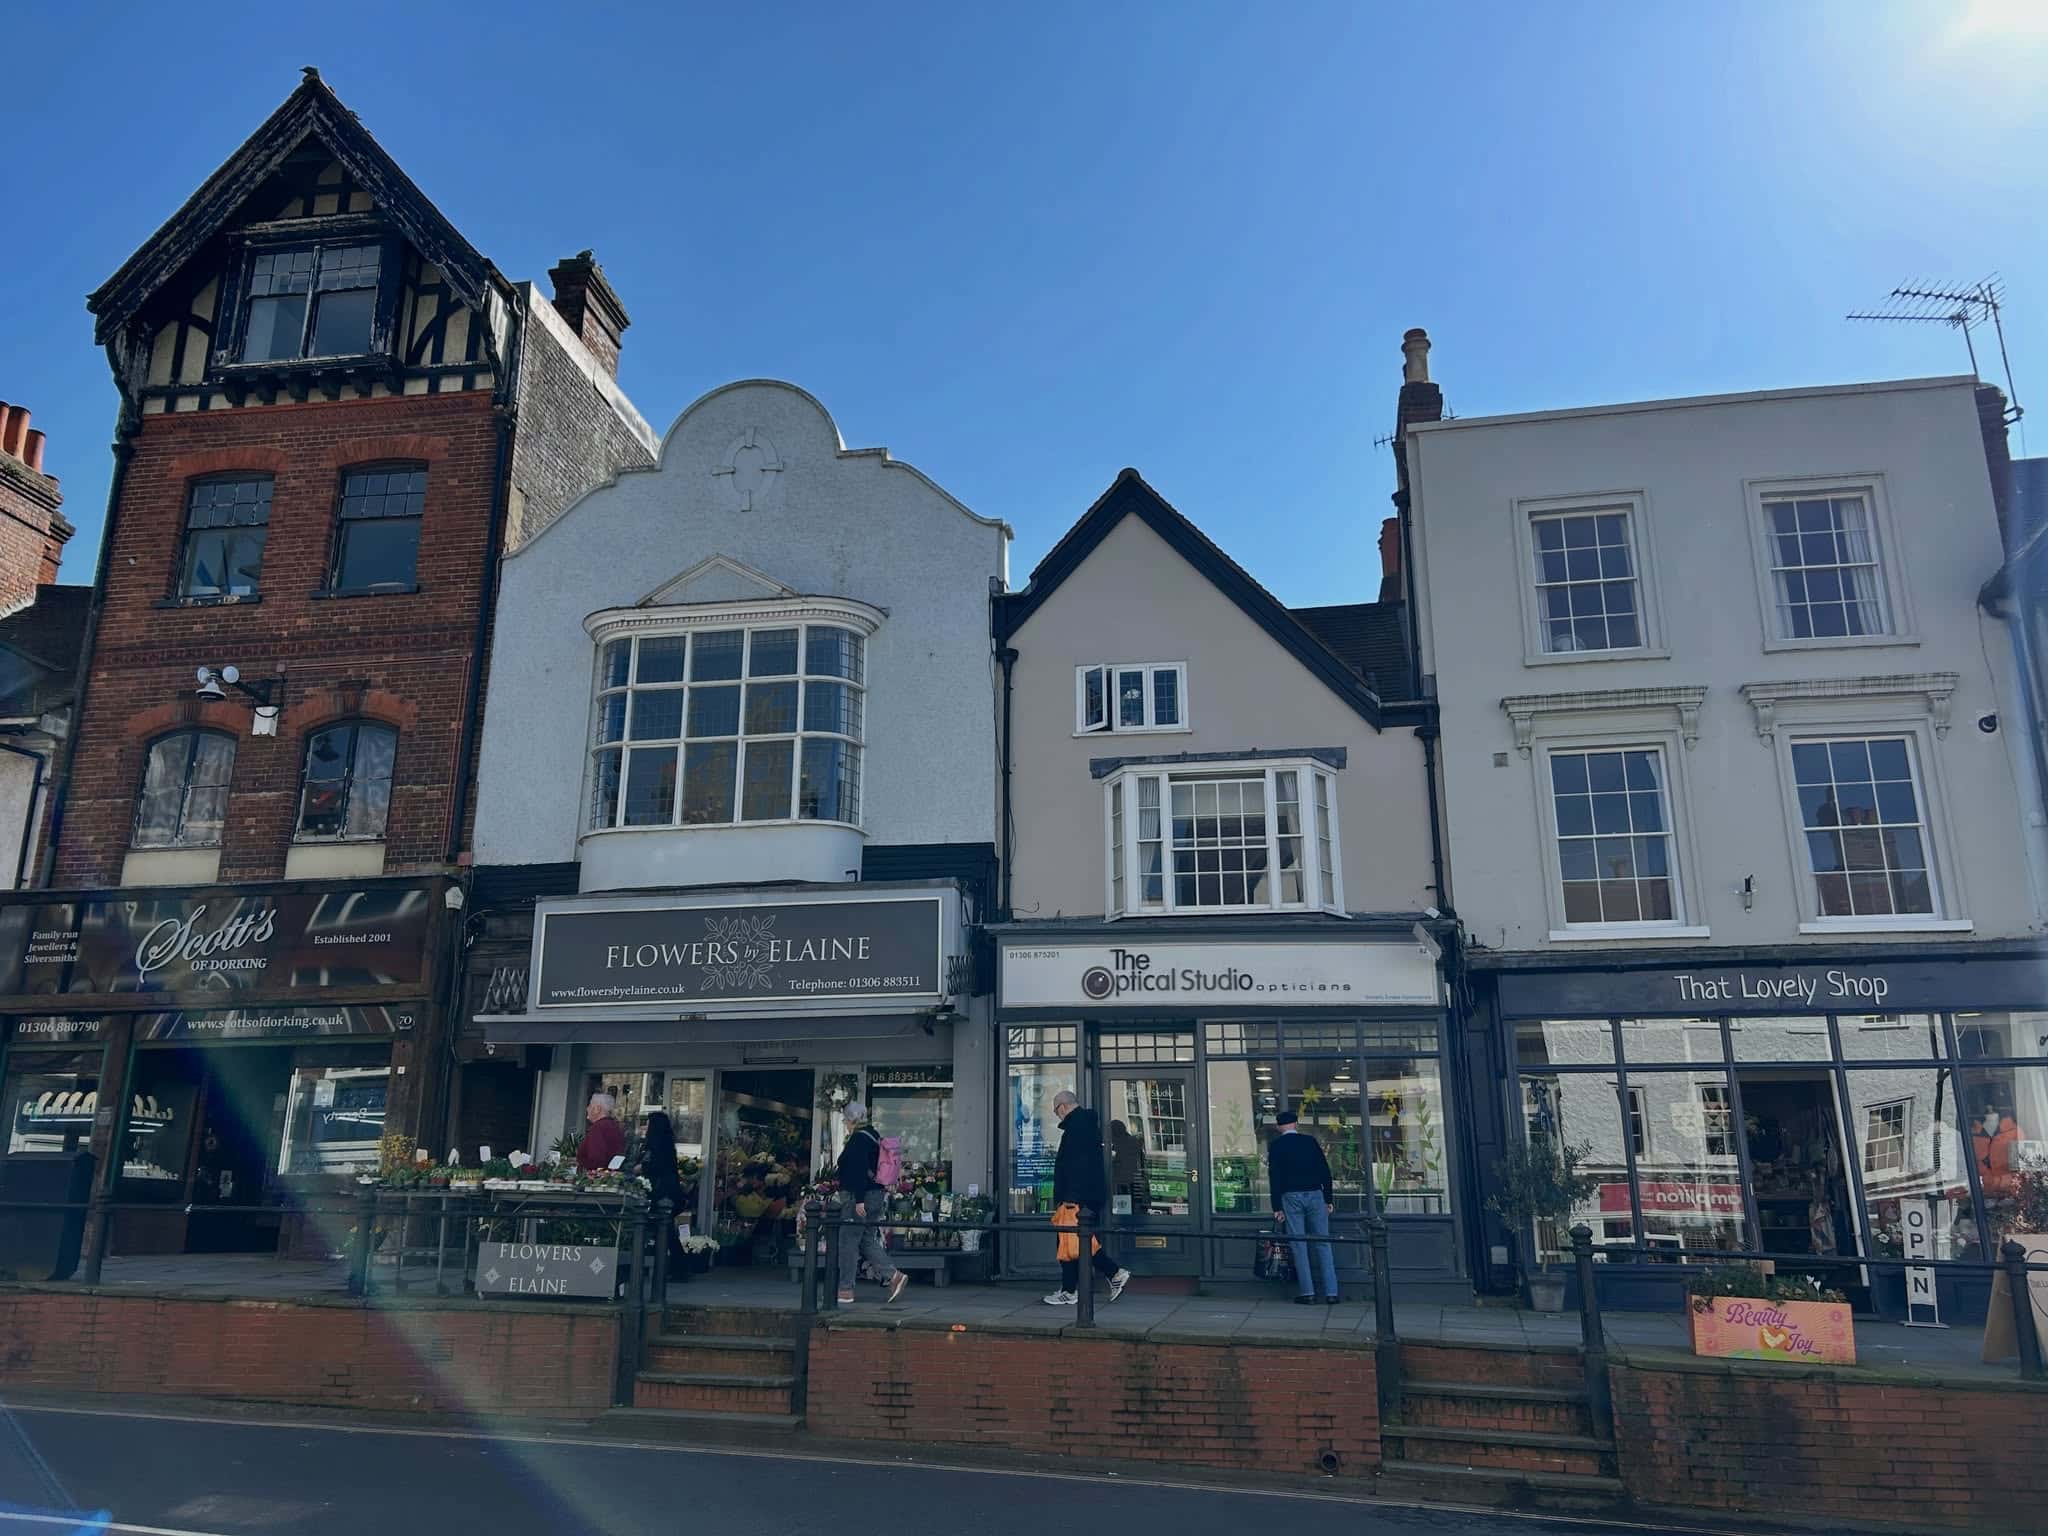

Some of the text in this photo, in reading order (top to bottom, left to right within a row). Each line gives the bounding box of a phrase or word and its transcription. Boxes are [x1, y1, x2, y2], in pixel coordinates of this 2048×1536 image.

[32, 931, 79, 941] Family run
[136, 904, 277, 983] Scott's
[314, 933, 392, 945] Established 2001
[28, 942, 77, 953] Jewellers &
[606, 937, 870, 968] FLOWERS by ELAINE
[1009, 951, 1032, 959] 01306
[24, 954, 78, 964] Silversmiths
[190, 958, 267, 971] OF DORKING
[1109, 949, 1150, 971] The
[788, 976, 921, 992] Telephone: 01306 883511
[1181, 967, 1254, 992] Studio
[551, 984, 685, 998] www.flowersbyelaine.co.uk
[1256, 982, 1352, 993] opticians
[1673, 970, 1888, 1005] That Lovely Shop
[19, 1021, 100, 1033] 01306 880790
[187, 1013, 344, 1030] www.scottsofdorking.co.uk
[399, 1015, 413, 1025] 70
[500, 1243, 582, 1262] FLOWERS
[535, 1264, 545, 1275] by
[509, 1277, 568, 1294] ELAINE
[1725, 1302, 1798, 1330] Beauty
[1784, 1333, 1823, 1355] Joy
